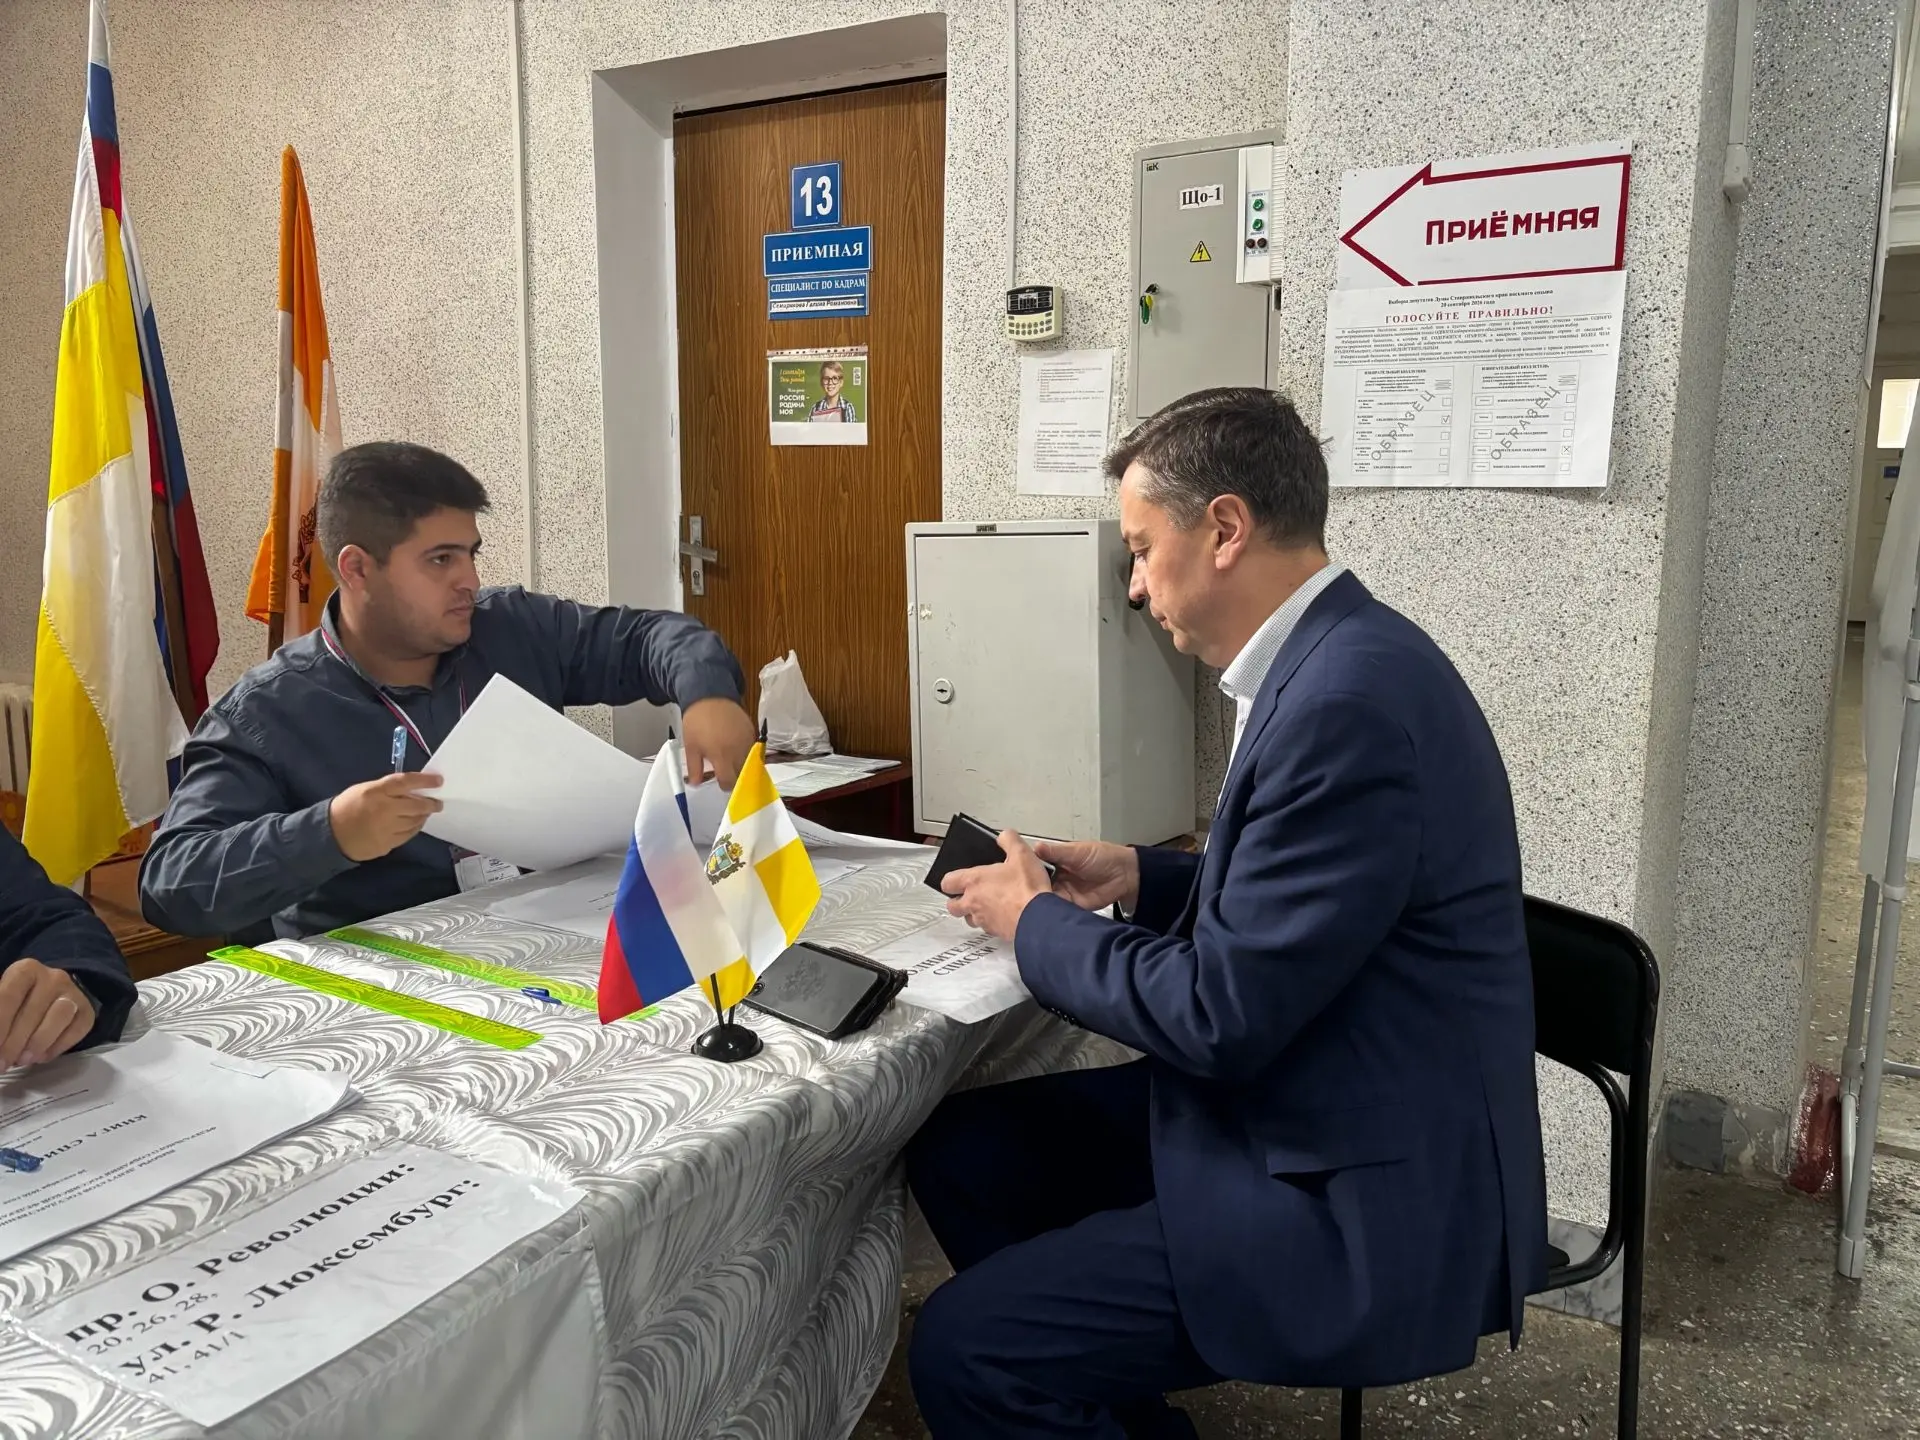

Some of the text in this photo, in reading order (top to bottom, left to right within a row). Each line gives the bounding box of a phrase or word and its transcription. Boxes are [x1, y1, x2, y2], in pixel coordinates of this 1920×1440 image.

[800, 175, 833, 217] 13
[1182, 187, 1222, 206] Що-1
[1425, 206, 1600, 246] ПРИЁМНАЯ
[771, 242, 864, 263] ПРИЕМНАЯ
[771, 278, 866, 293] СПЕЦИАЛИСТ ПО КАДРАМ
[1385, 306, 1554, 324] ГОЛОСУЙТЕ ПРАВИЛЬНО!
[1371, 390, 1436, 461] ОБРАЗЕЦ
[1490, 386, 1560, 460] ОБРАЗЕЦ
[908, 932, 994, 976] ОЛНИТЕЛЬН
[933, 946, 998, 976] СПИСКИ
[86, 1113, 148, 1139] КНИГА
[38, 1139, 83, 1163] СПИ
[63, 1163, 416, 1345] пр. О. Революции:
[119, 1179, 481, 1380] ул. Р. Люксембург:
[85, 1289, 219, 1356] 20, 26, 28,
[145, 1329, 249, 1387] 41, 41/1
